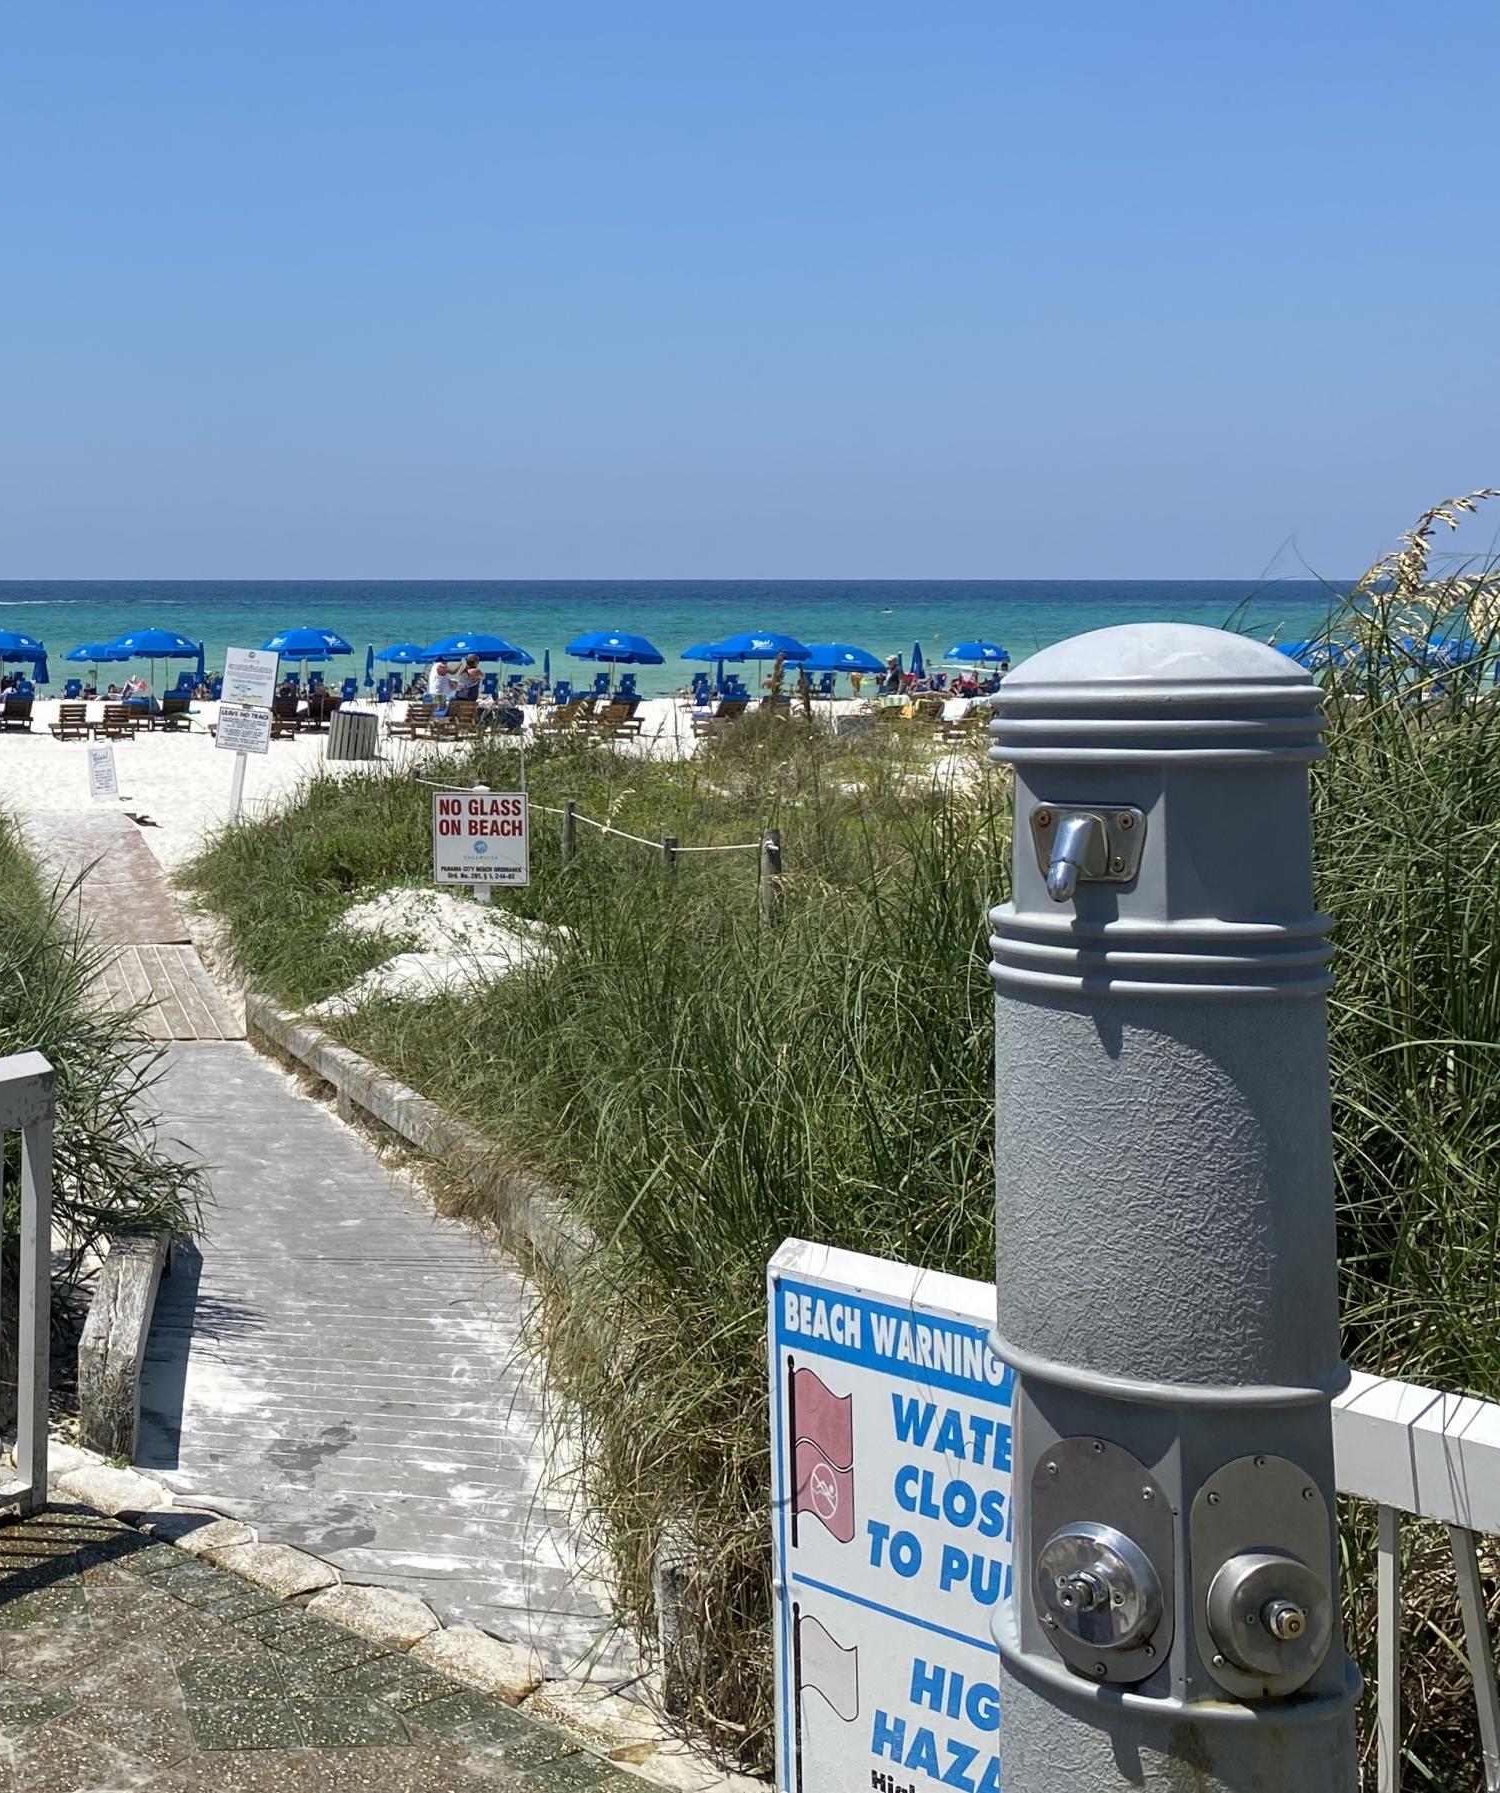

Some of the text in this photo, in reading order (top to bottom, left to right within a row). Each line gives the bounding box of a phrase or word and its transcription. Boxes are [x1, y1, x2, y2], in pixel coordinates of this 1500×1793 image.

[439, 799, 522, 816] NO GLASS
[439, 819, 523, 836] ON BEACH
[784, 1290, 1004, 1386] BEACH WARNING
[894, 1464, 1012, 1543] CLOS
[867, 1519, 1012, 1606] TO PU
